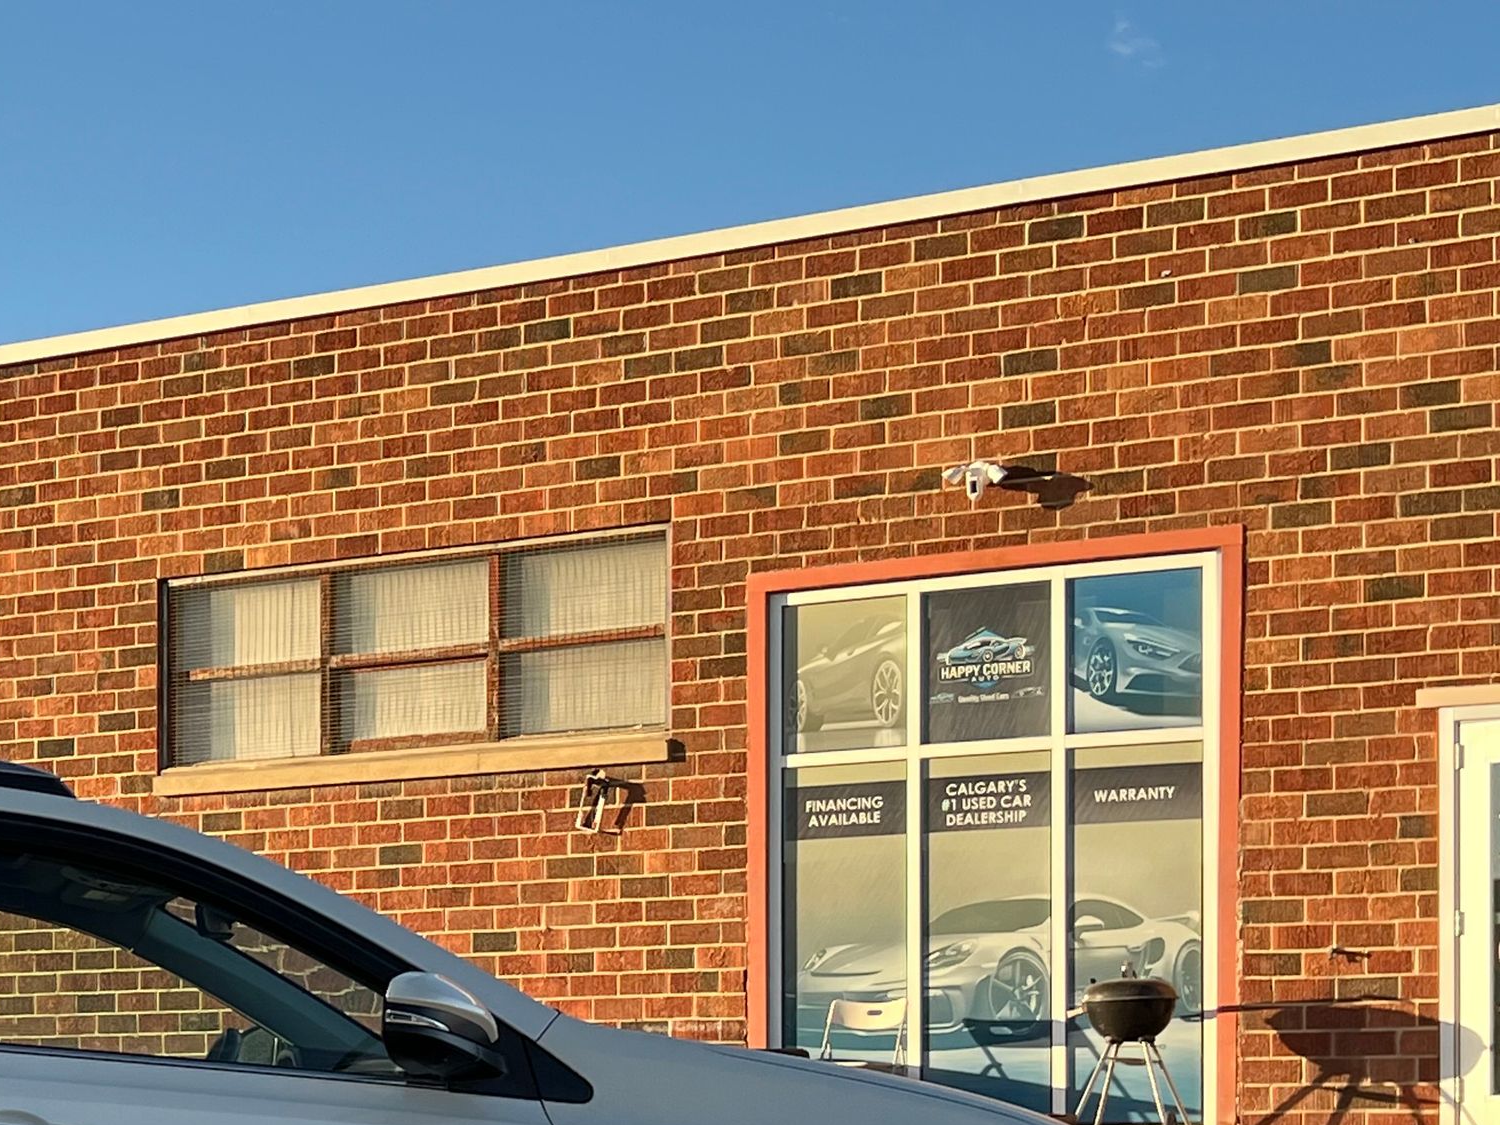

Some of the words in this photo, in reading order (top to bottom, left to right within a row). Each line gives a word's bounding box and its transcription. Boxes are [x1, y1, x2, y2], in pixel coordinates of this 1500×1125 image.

[941, 665, 981, 680] HAPPY
[983, 660, 1031, 676] CORNER
[945, 779, 1027, 796] CALGARY'S
[1094, 786, 1175, 803] WARRANTY
[805, 796, 884, 813] FINANCING
[941, 799, 957, 811] #1
[962, 796, 997, 810] USED
[1000, 794, 1032, 808] CAR
[808, 810, 881, 827] AVAILABLE
[945, 810, 1027, 826] DEALERSHIP
